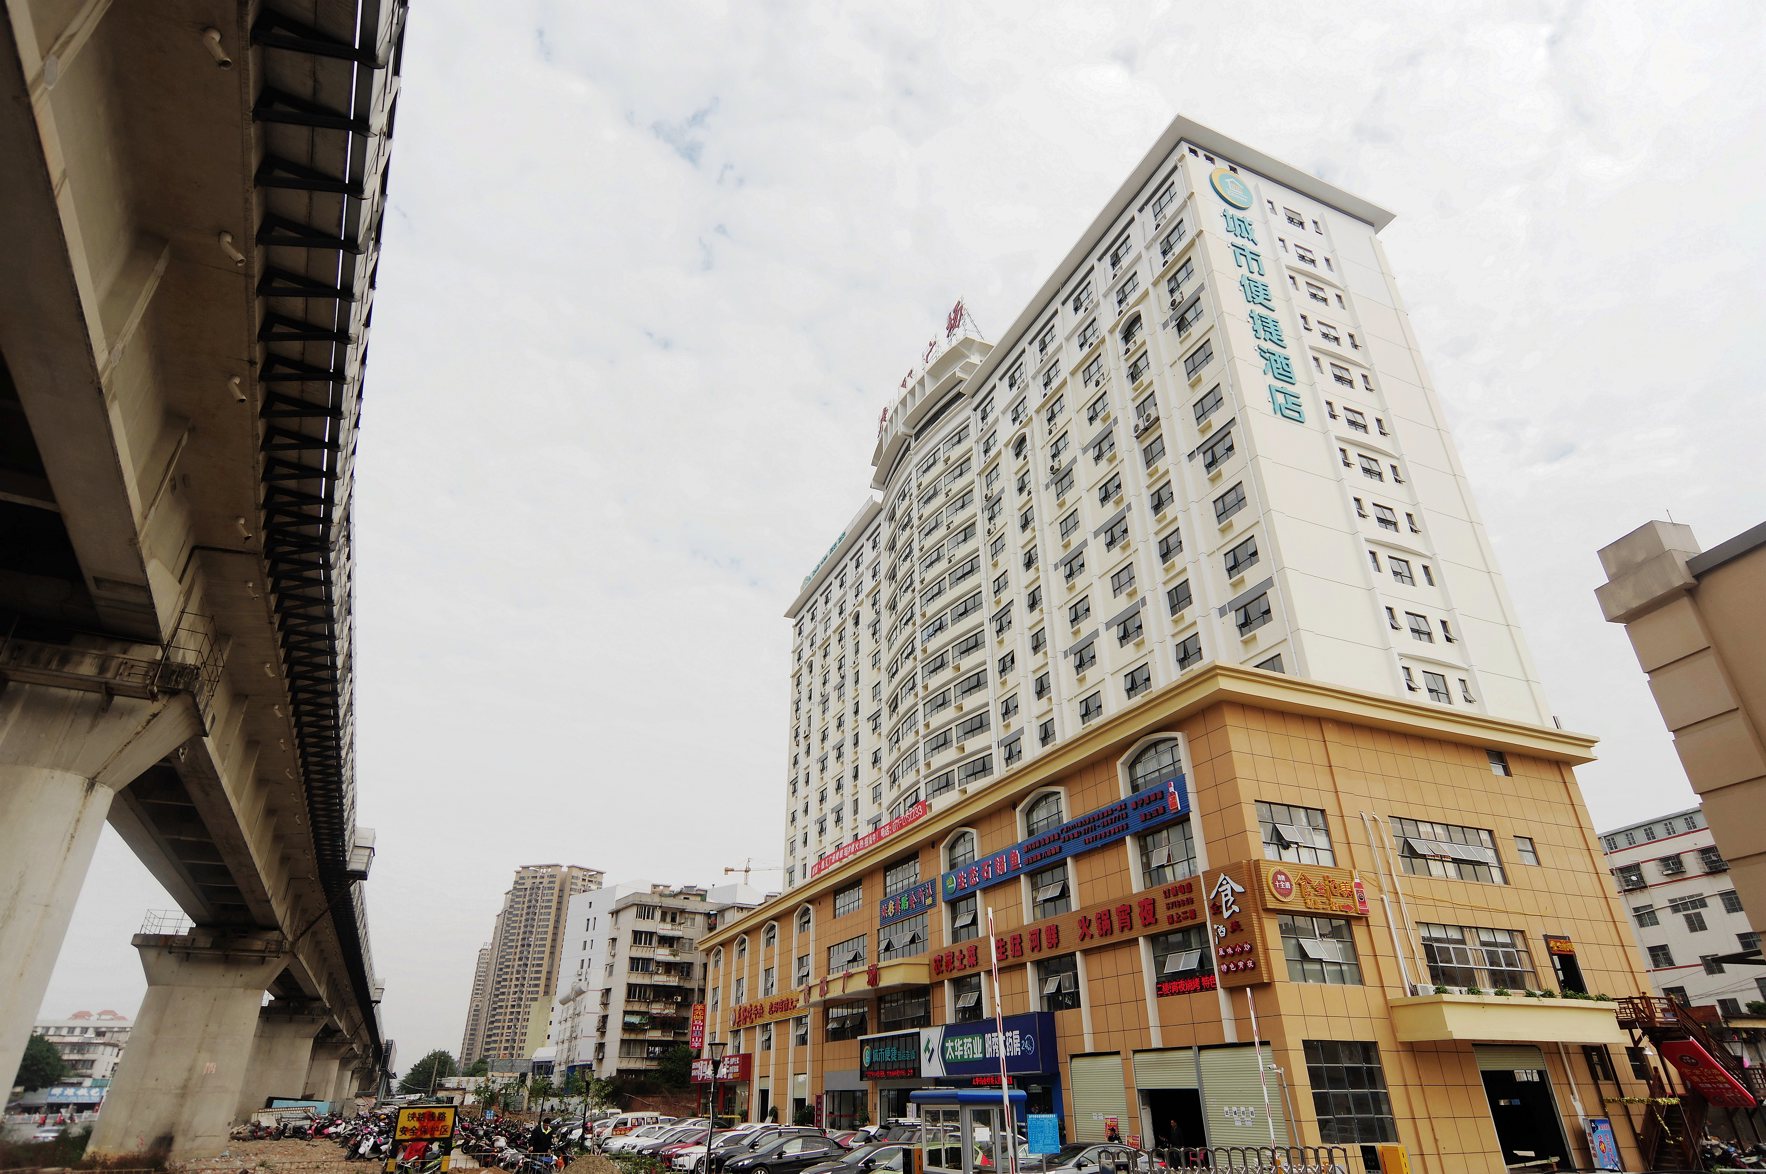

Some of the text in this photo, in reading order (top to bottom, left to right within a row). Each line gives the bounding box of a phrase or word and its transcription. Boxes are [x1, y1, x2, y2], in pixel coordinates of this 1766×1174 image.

[1222, 208, 1305, 424] 城市便捷酒店
[957, 849, 1022, 891] 生态石锅鱼
[933, 897, 1158, 976] 农家土菜 生猛河鲜 火锅宵夜
[1218, 942, 1252, 957] 风味小炒
[1221, 959, 1254, 974] 特色宵夜
[407, 1112, 447, 1122] 铁路线路
[399, 1125, 449, 1137] 安全保护区
